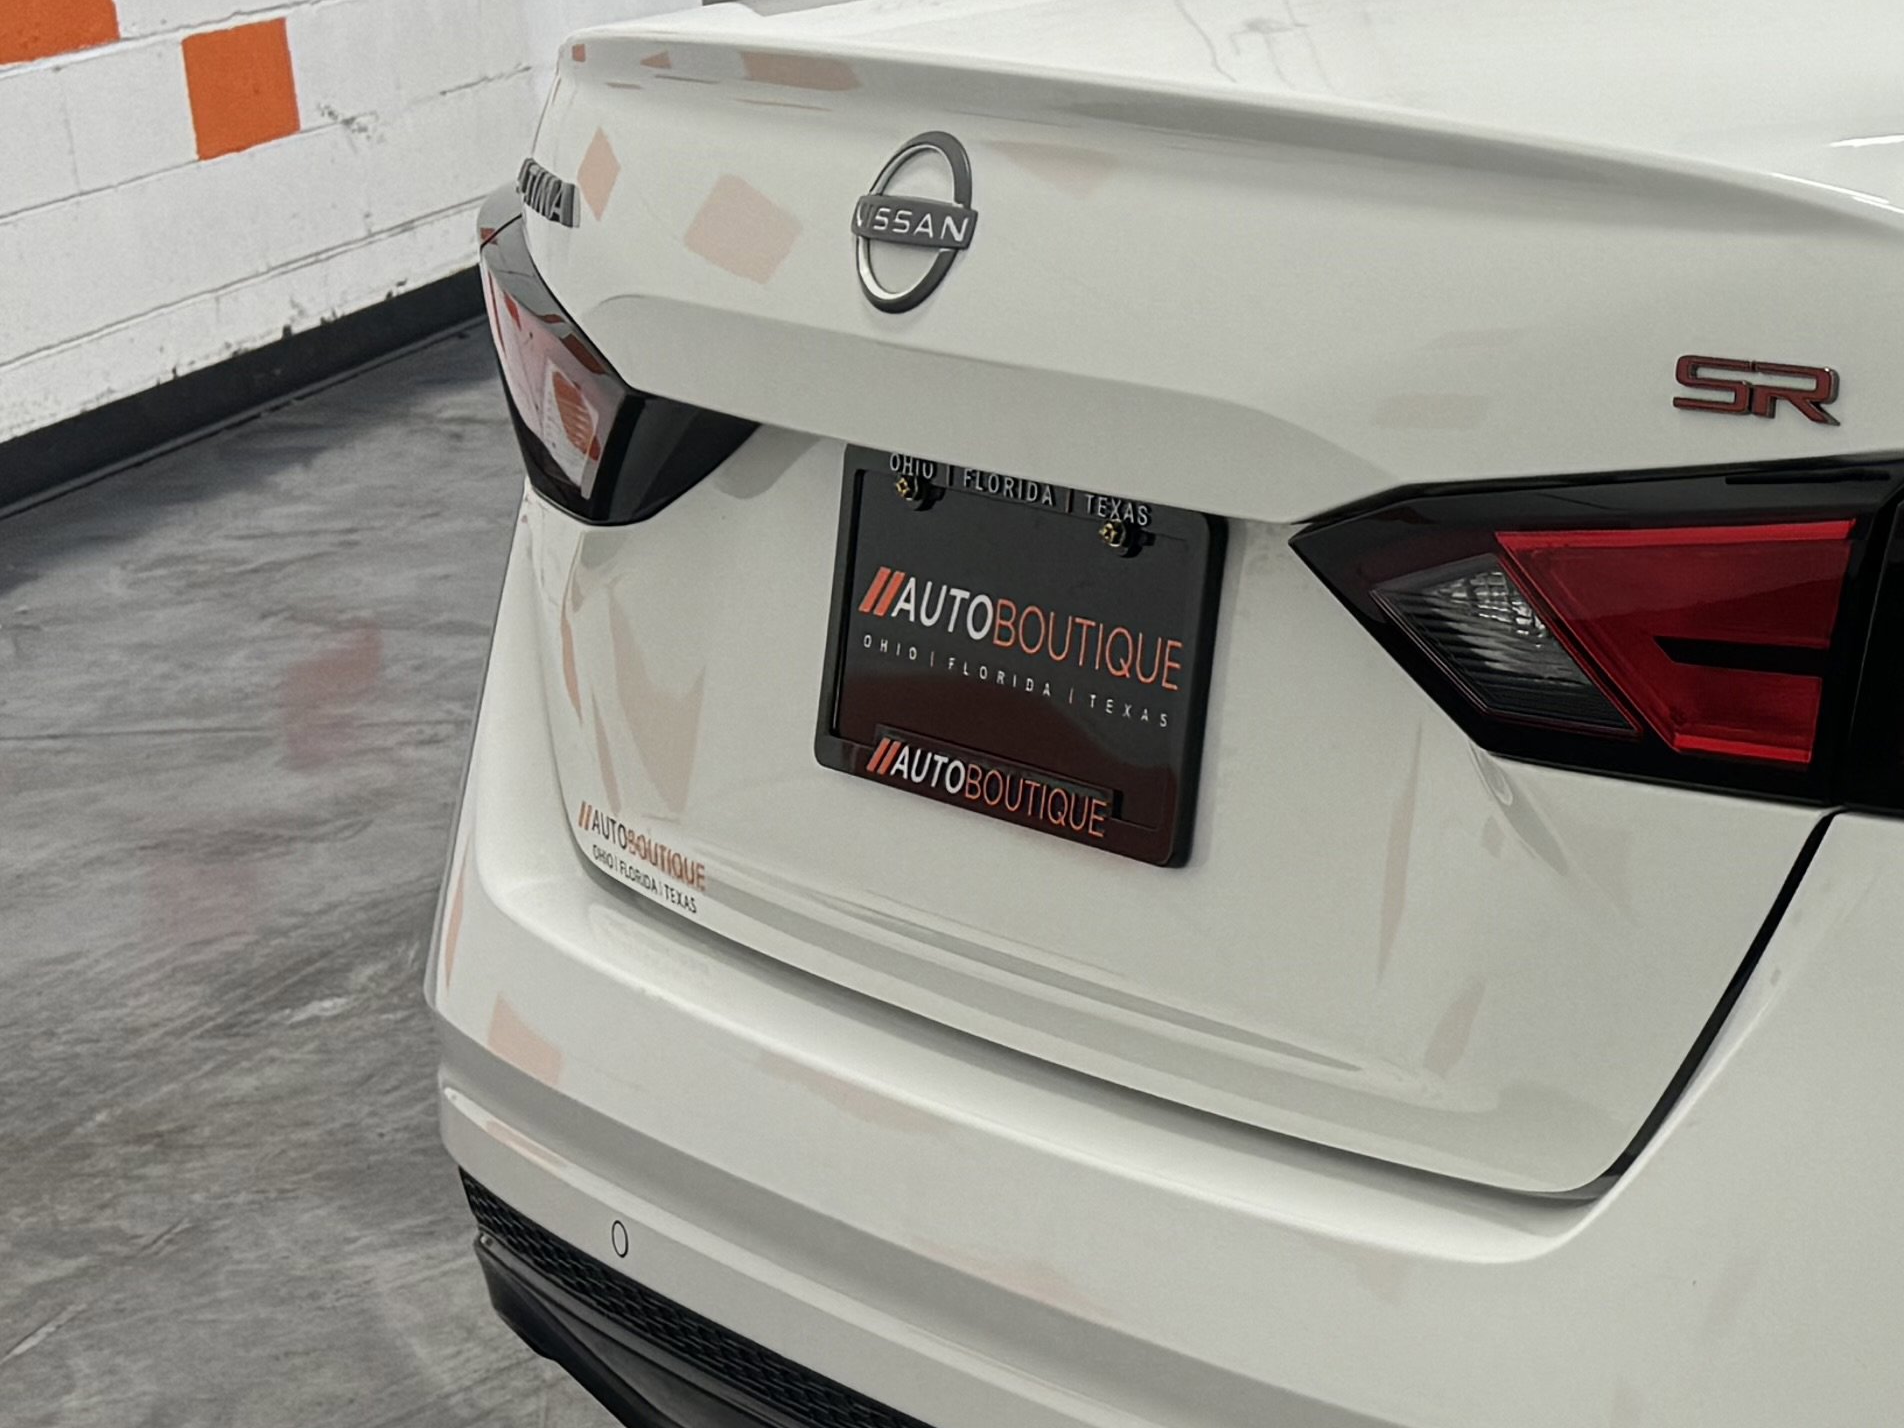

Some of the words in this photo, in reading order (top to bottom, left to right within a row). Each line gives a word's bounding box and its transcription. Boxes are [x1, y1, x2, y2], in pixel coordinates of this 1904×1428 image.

[1673, 355, 1841, 427] SR
[889, 452, 934, 479] OHIO
[962, 469, 1054, 507] FLORIDA
[1085, 493, 1150, 526] TEXAS
[863, 634, 917, 661] OHIO
[948, 657, 1051, 697] FLORIDA
[1090, 694, 1169, 728] TEXAS
[664, 883, 697, 914] TEXAS
